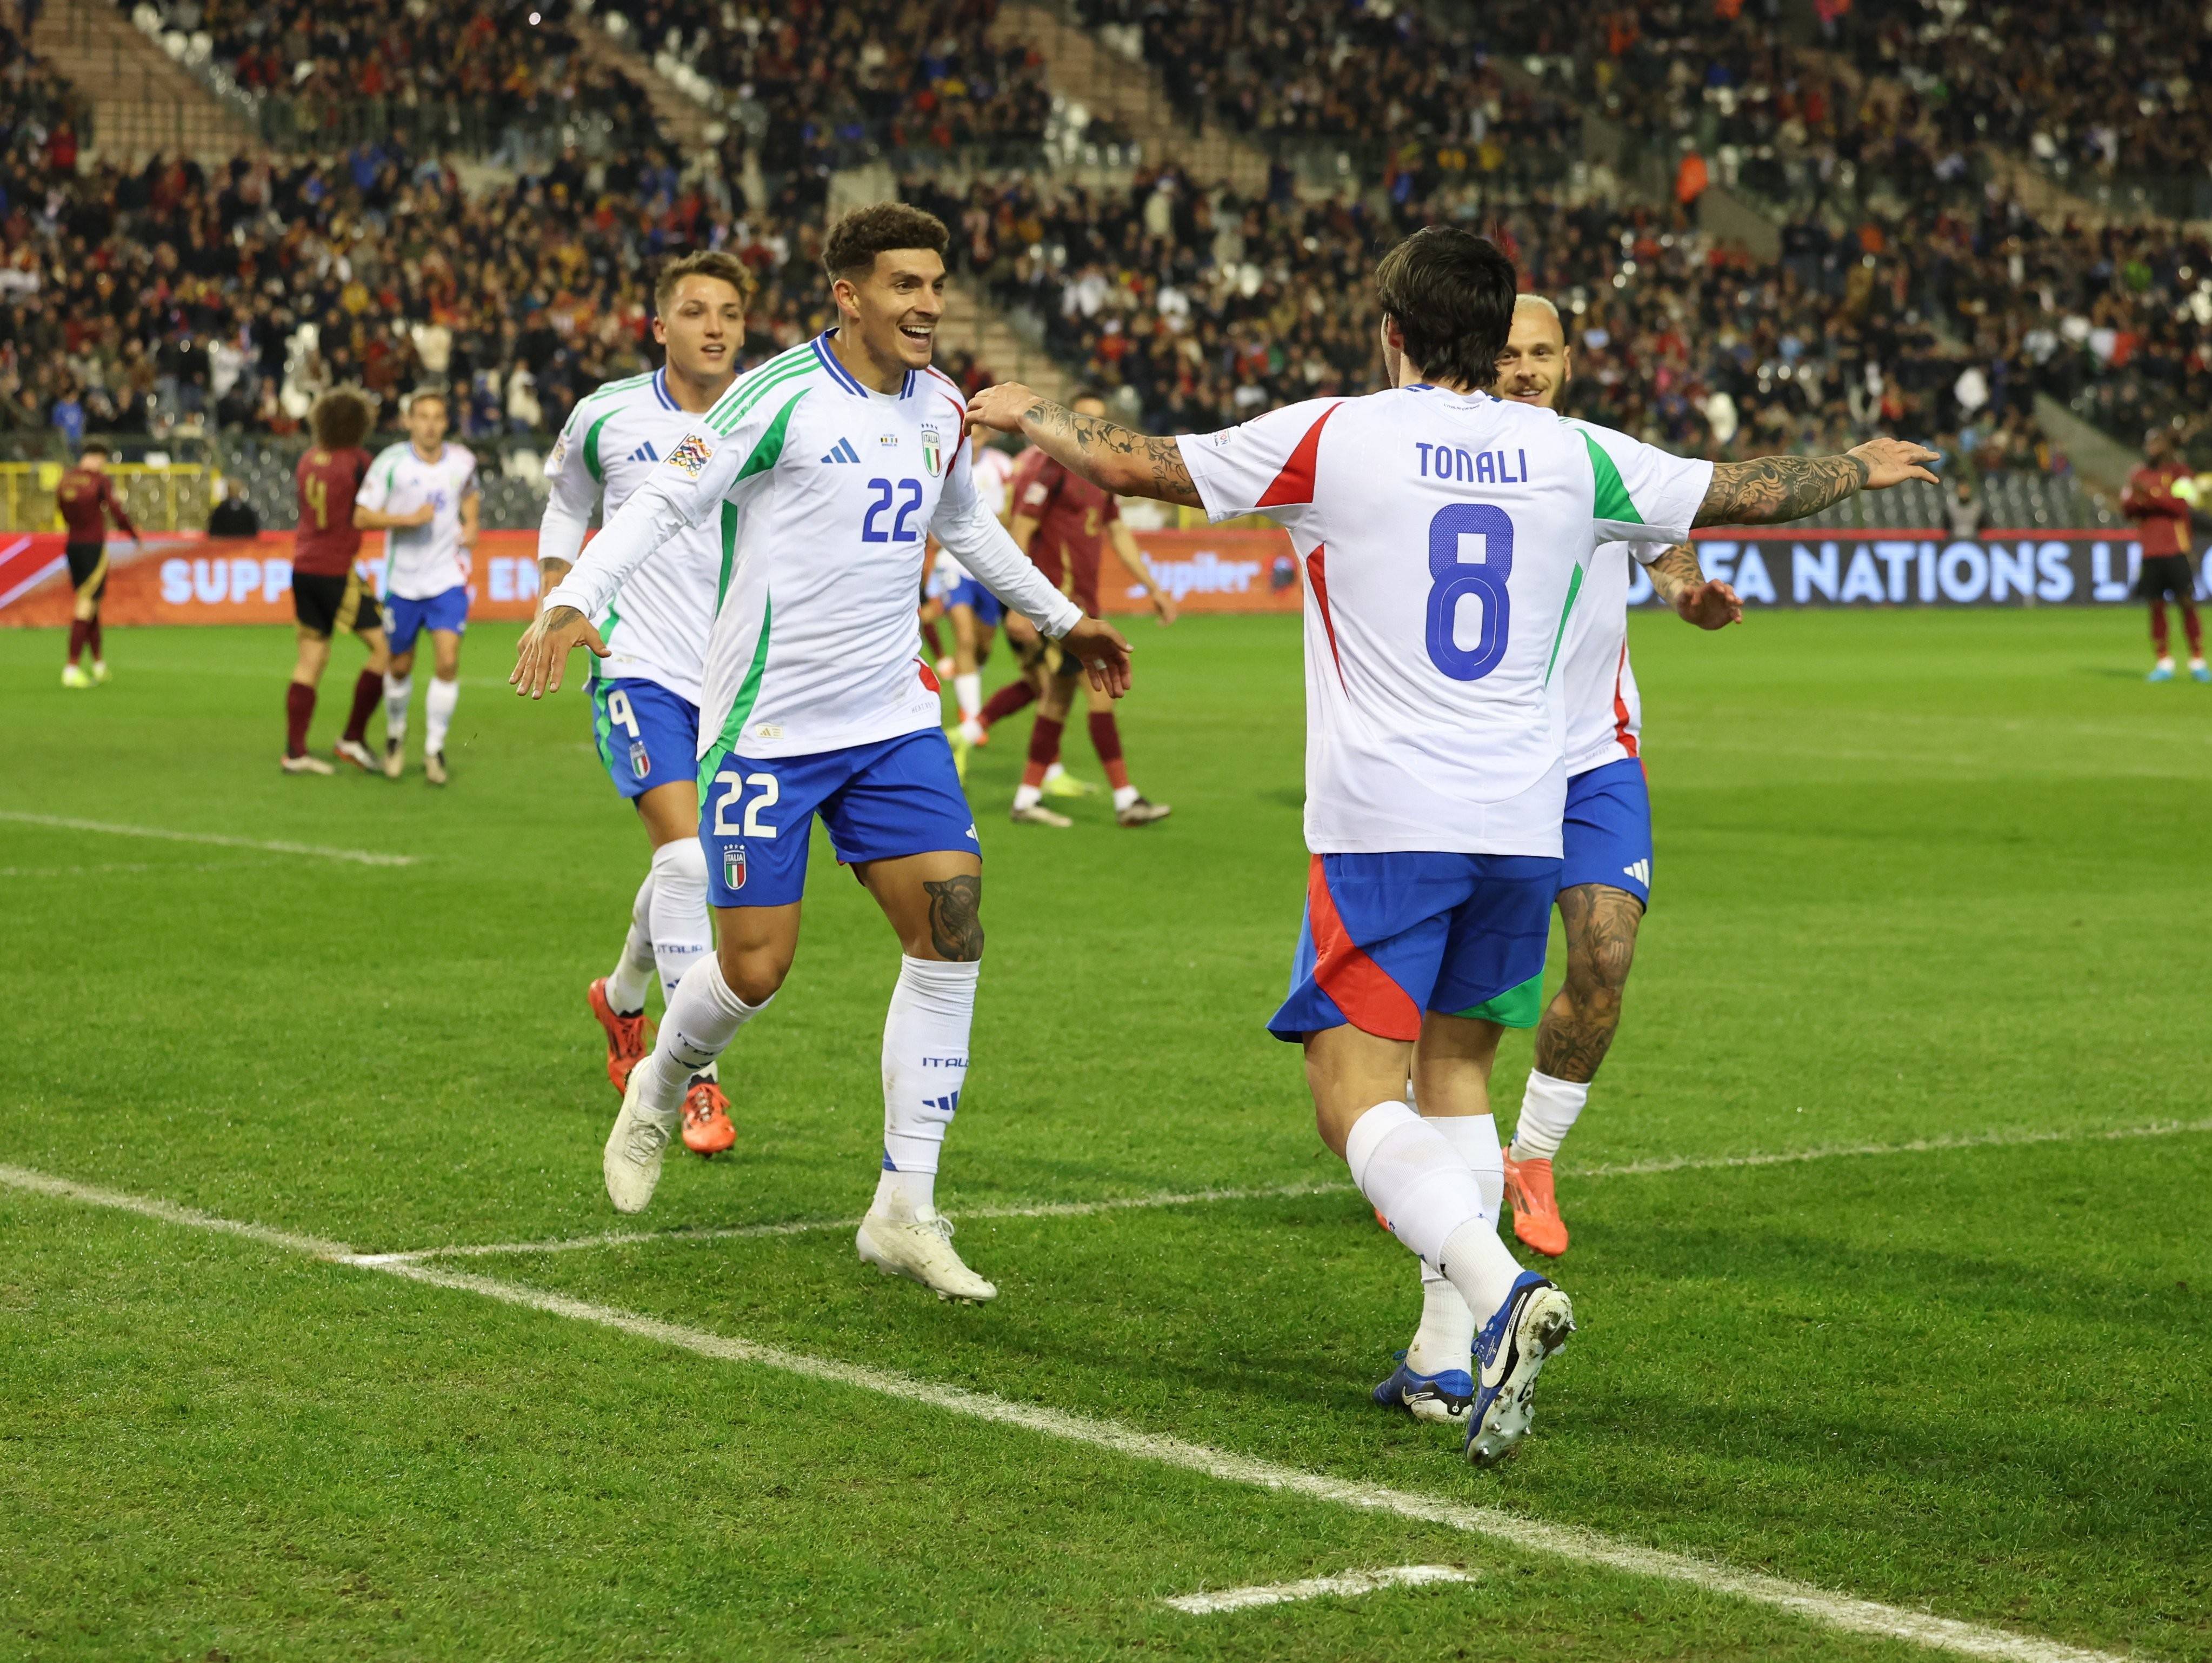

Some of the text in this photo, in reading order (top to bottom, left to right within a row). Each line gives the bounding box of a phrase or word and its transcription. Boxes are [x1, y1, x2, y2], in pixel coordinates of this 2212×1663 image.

[923, 434, 938, 443] ITALIA
[1416, 442, 1528, 483] TONALI
[862, 478, 922, 542] 22
[1426, 503, 1514, 681] 8
[1791, 541, 2075, 602] NATIONS
[608, 688, 641, 738] 9
[714, 770, 779, 838] 22
[726, 853, 743, 862] ITALIA
[658, 943, 703, 954] ITALIA
